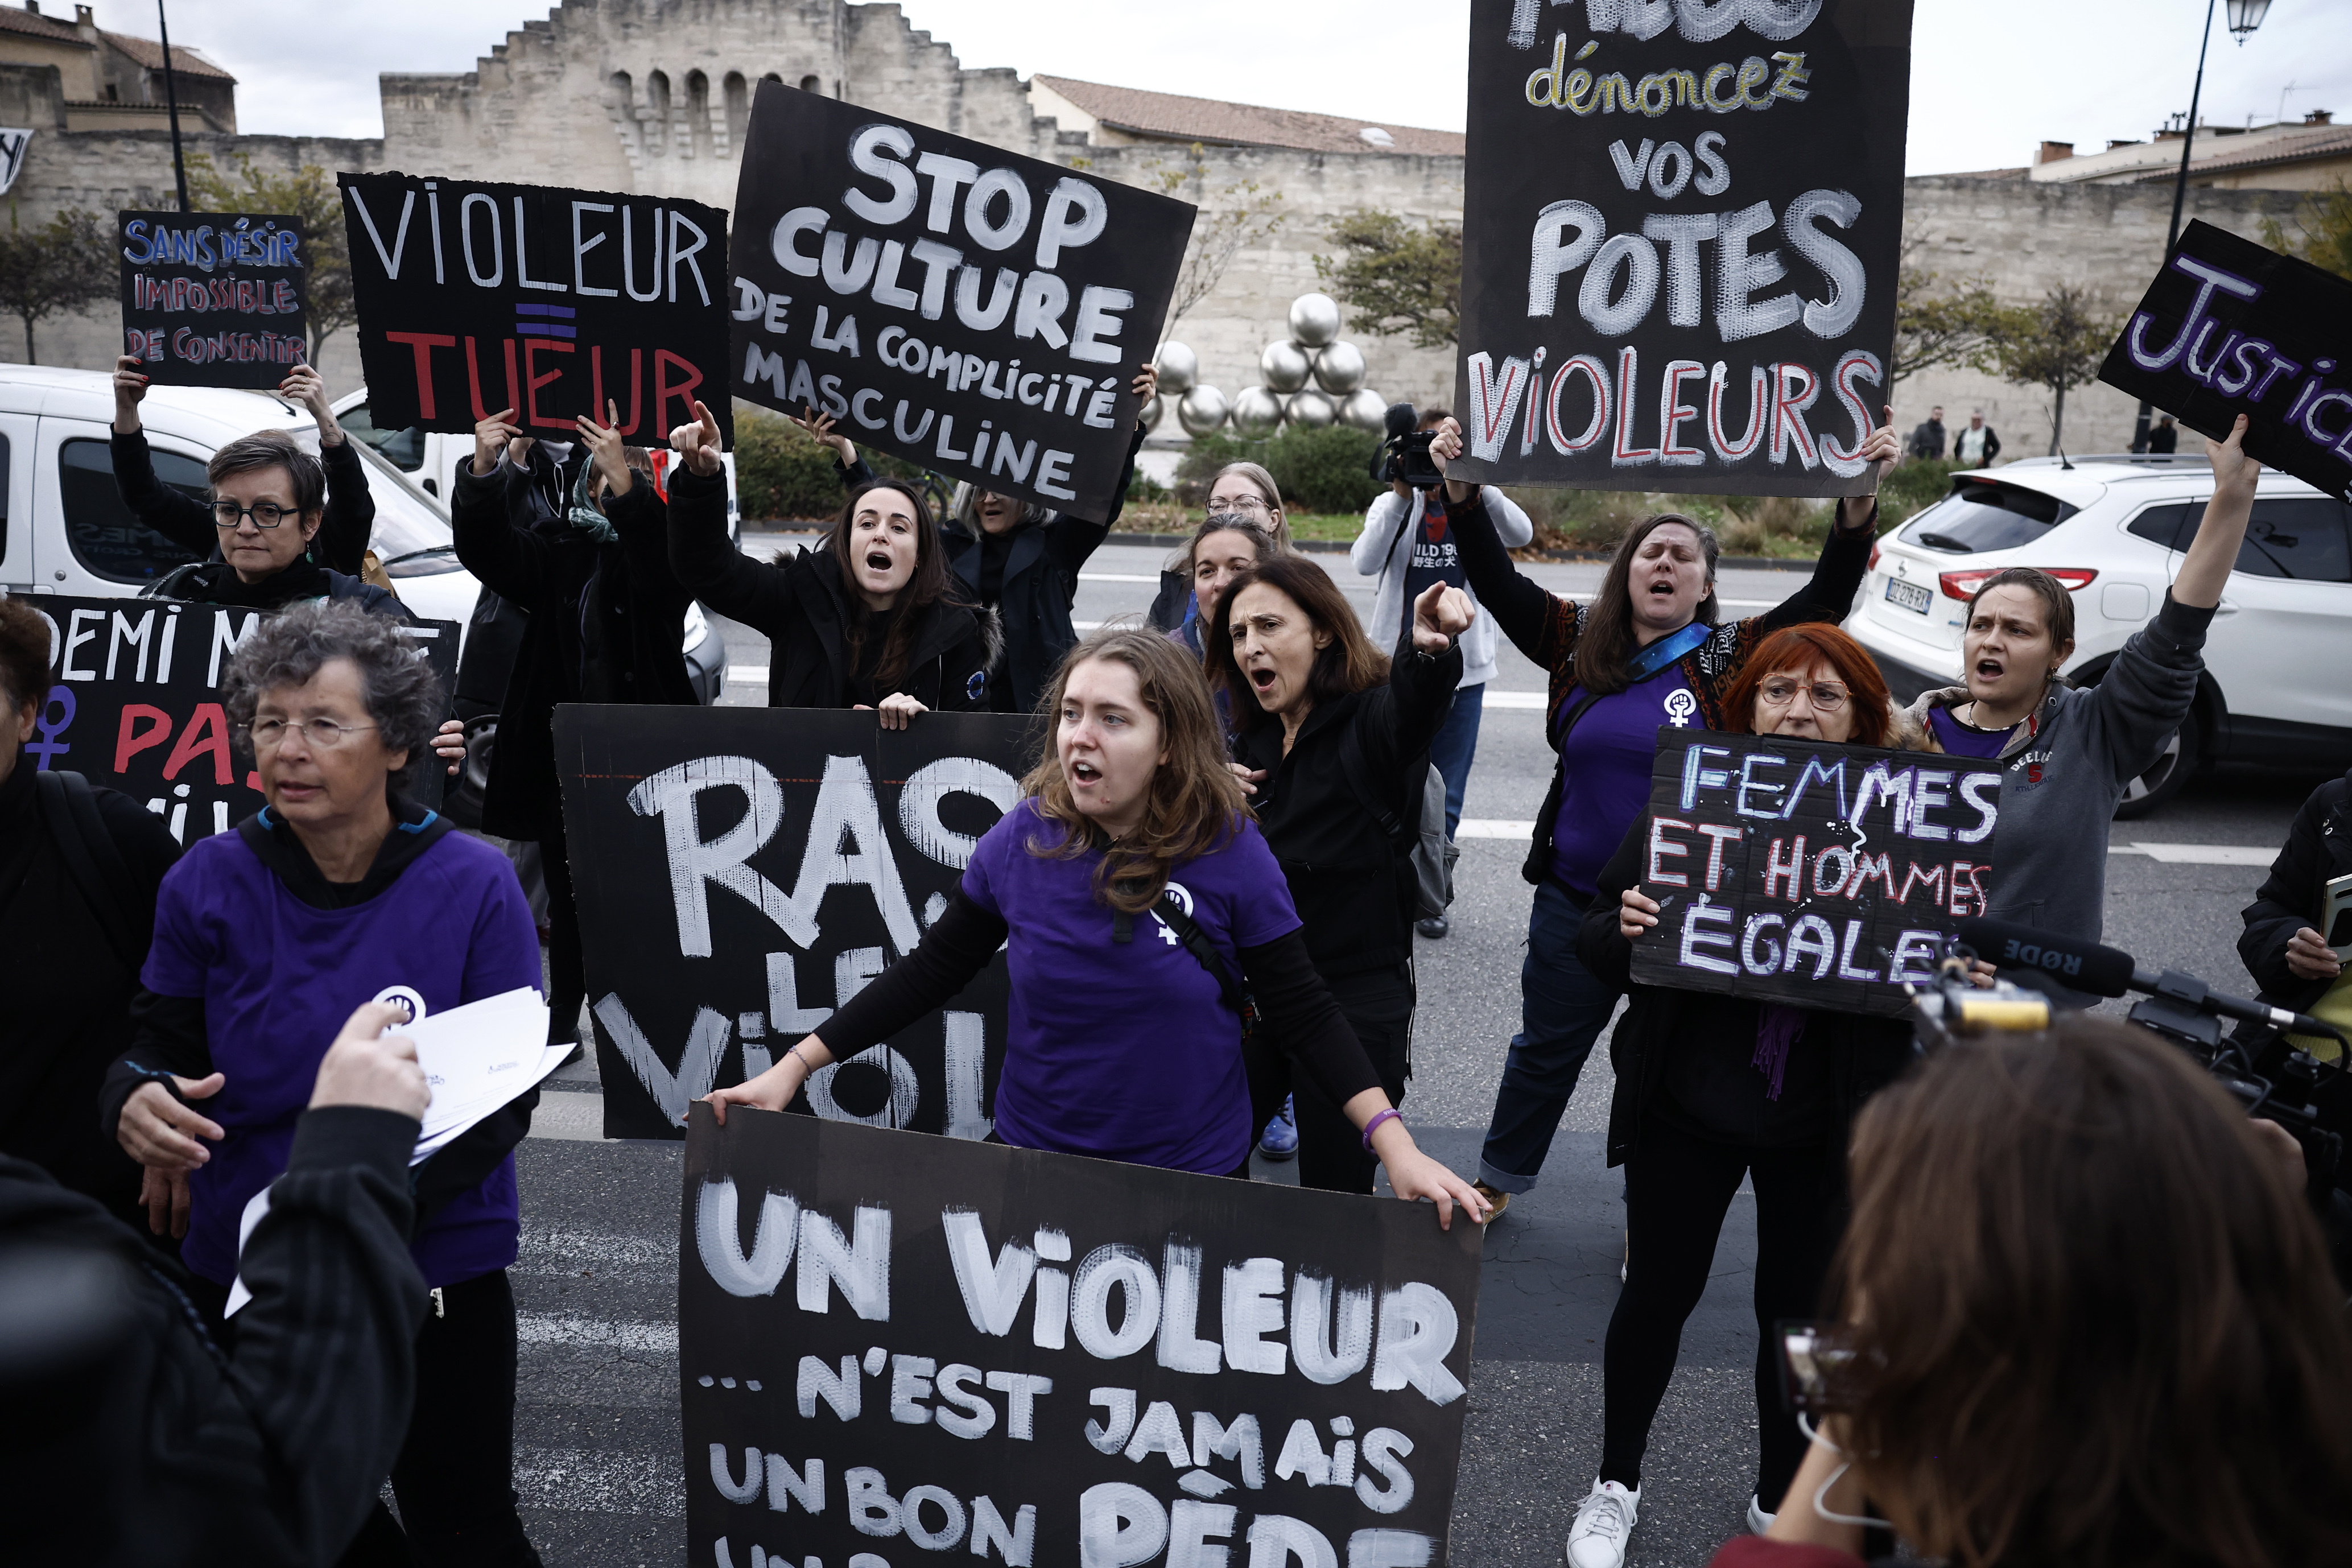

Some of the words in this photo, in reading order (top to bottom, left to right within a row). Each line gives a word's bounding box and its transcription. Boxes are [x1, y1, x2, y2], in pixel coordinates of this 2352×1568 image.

[1525, 30, 1814, 117] dénoncez
[841, 123, 1108, 269] STOP
[123, 219, 218, 272] SANS
[770, 206, 1134, 364] CULTURE
[1527, 189, 1867, 341] POTES
[125, 327, 165, 361] DE
[732, 276, 793, 334] DE
[811, 305, 861, 357] LA
[386, 331, 703, 440] TUEUR
[1416, 543, 1439, 557] ILD
[114, 703, 263, 794] PA
[1680, 744, 2002, 843] FEMMES
[1648, 816, 1743, 892] ET
[1765, 835, 1992, 917] HOMMES
[1678, 892, 1959, 985] ÉGALE
[2003, 939, 2082, 975] RØDE
[695, 1174, 893, 1322] UN
[797, 1346, 1053, 1441] N'EST
[709, 1443, 826, 1516] UN
[845, 1466, 1037, 1567] BON
